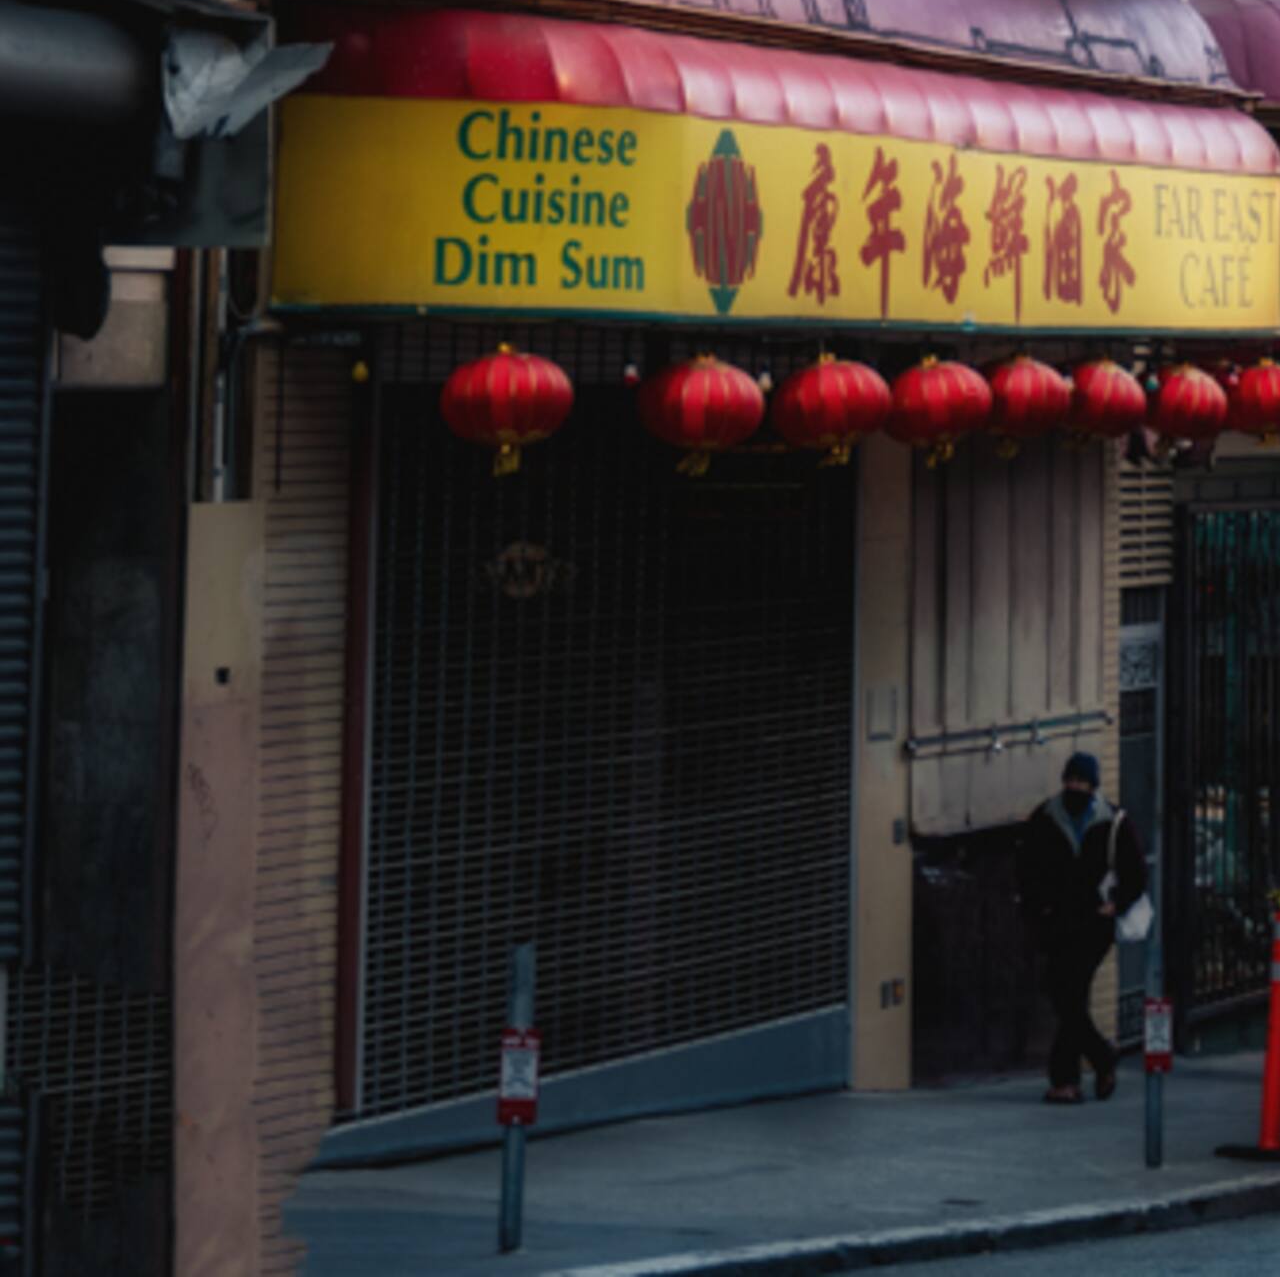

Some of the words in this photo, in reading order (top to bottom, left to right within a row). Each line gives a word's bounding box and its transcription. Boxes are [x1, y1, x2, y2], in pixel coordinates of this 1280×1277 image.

[457, 110, 639, 166] Chinese
[461, 173, 630, 229] Cuisine
[1154, 184, 1206, 242] FAR
[1215, 187, 1277, 244] EAST
[787, 141, 1137, 325] 康年海鮮酒家
[433, 236, 537, 287] Dim
[560, 240, 646, 291] Sum
